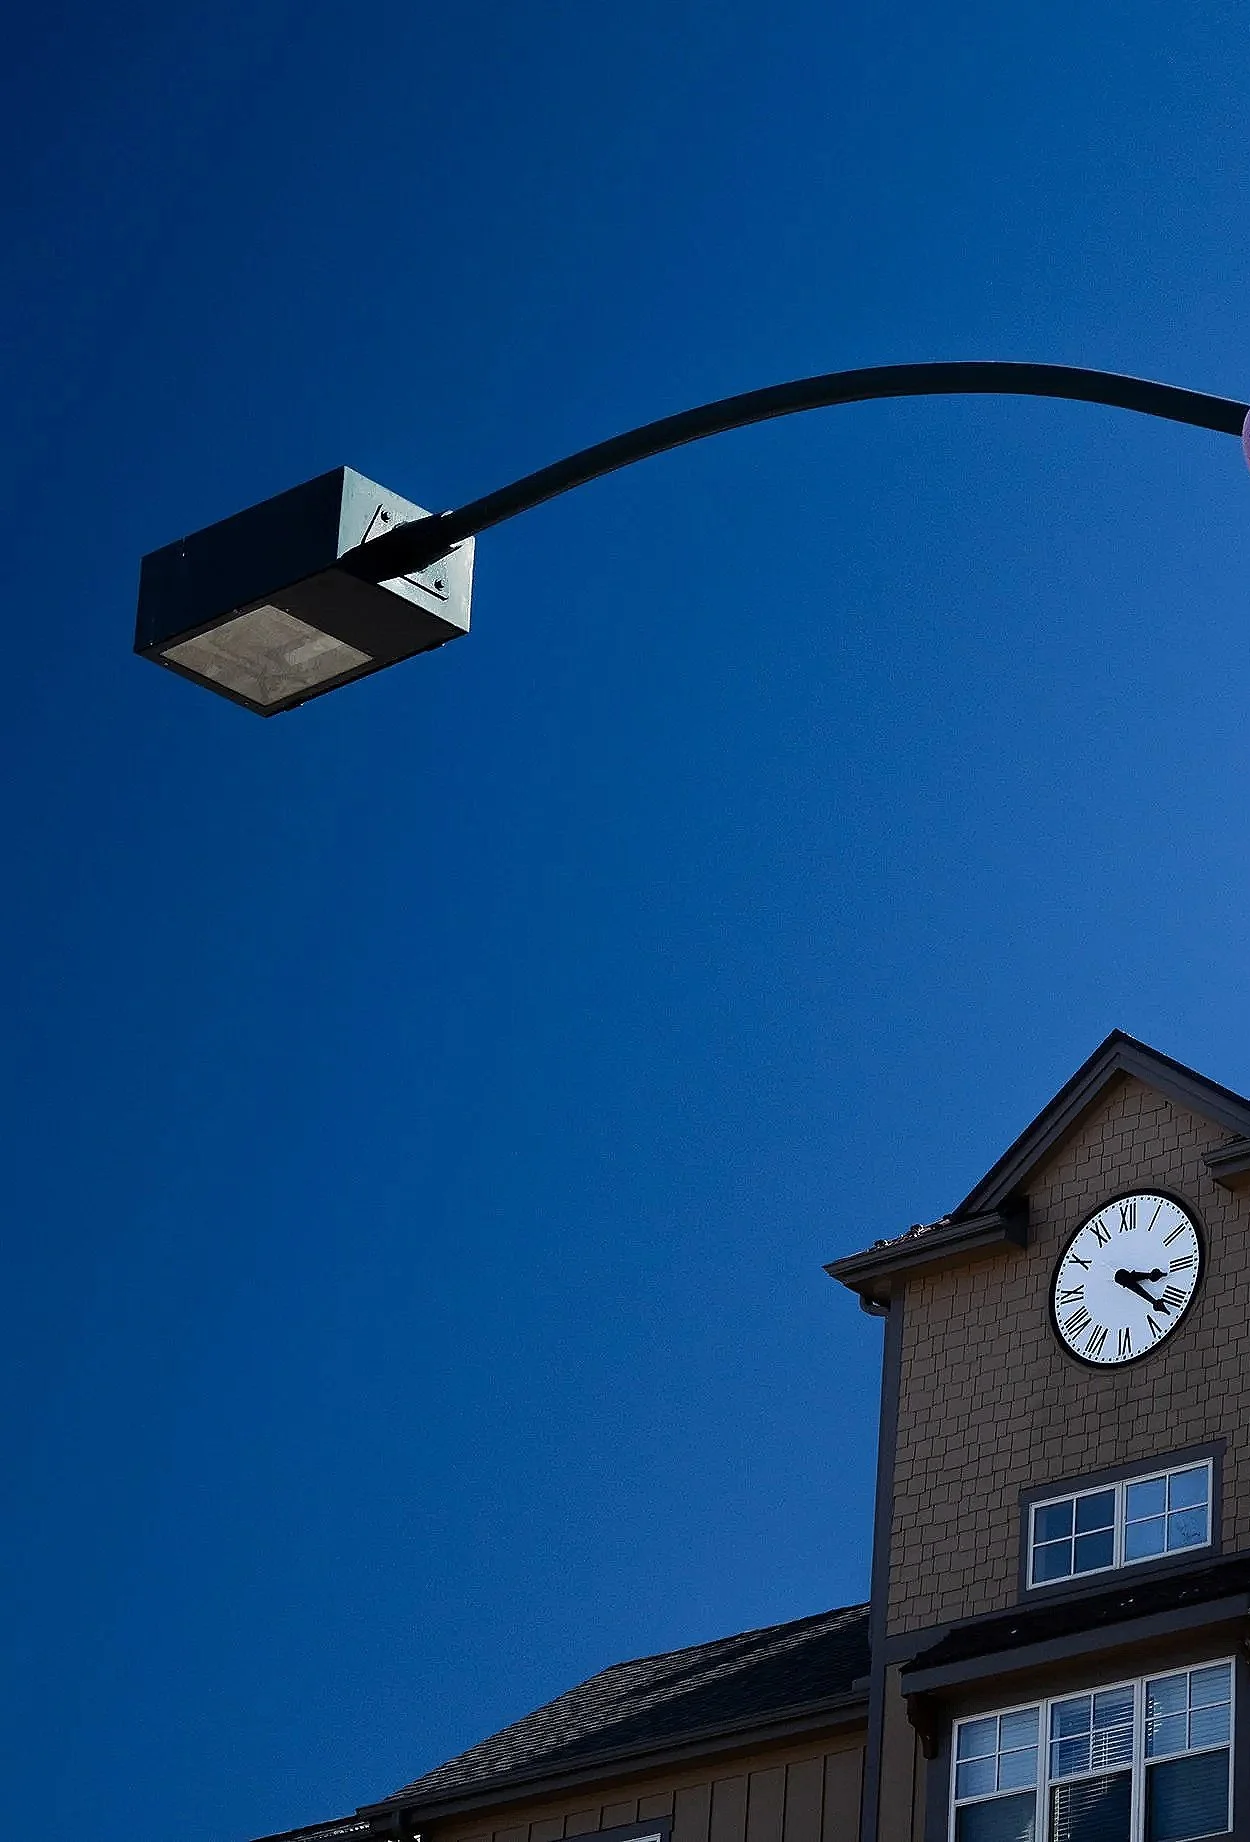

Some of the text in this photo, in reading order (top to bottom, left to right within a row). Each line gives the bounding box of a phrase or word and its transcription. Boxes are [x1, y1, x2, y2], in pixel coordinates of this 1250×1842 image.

[1120, 1203, 1137, 1233] XII
[1148, 1204, 1161, 1231] I
[1090, 1219, 1111, 1248] XI
[1163, 1223, 1186, 1246] II
[1069, 1254, 1092, 1270] X
[1170, 1255, 1193, 1272] III
[1061, 1285, 1084, 1304] IX
[1064, 1306, 1092, 1340] VIII
[1147, 1315, 1162, 1338] V
[1085, 1324, 1108, 1356] VII
[1118, 1327, 1132, 1356] VI
